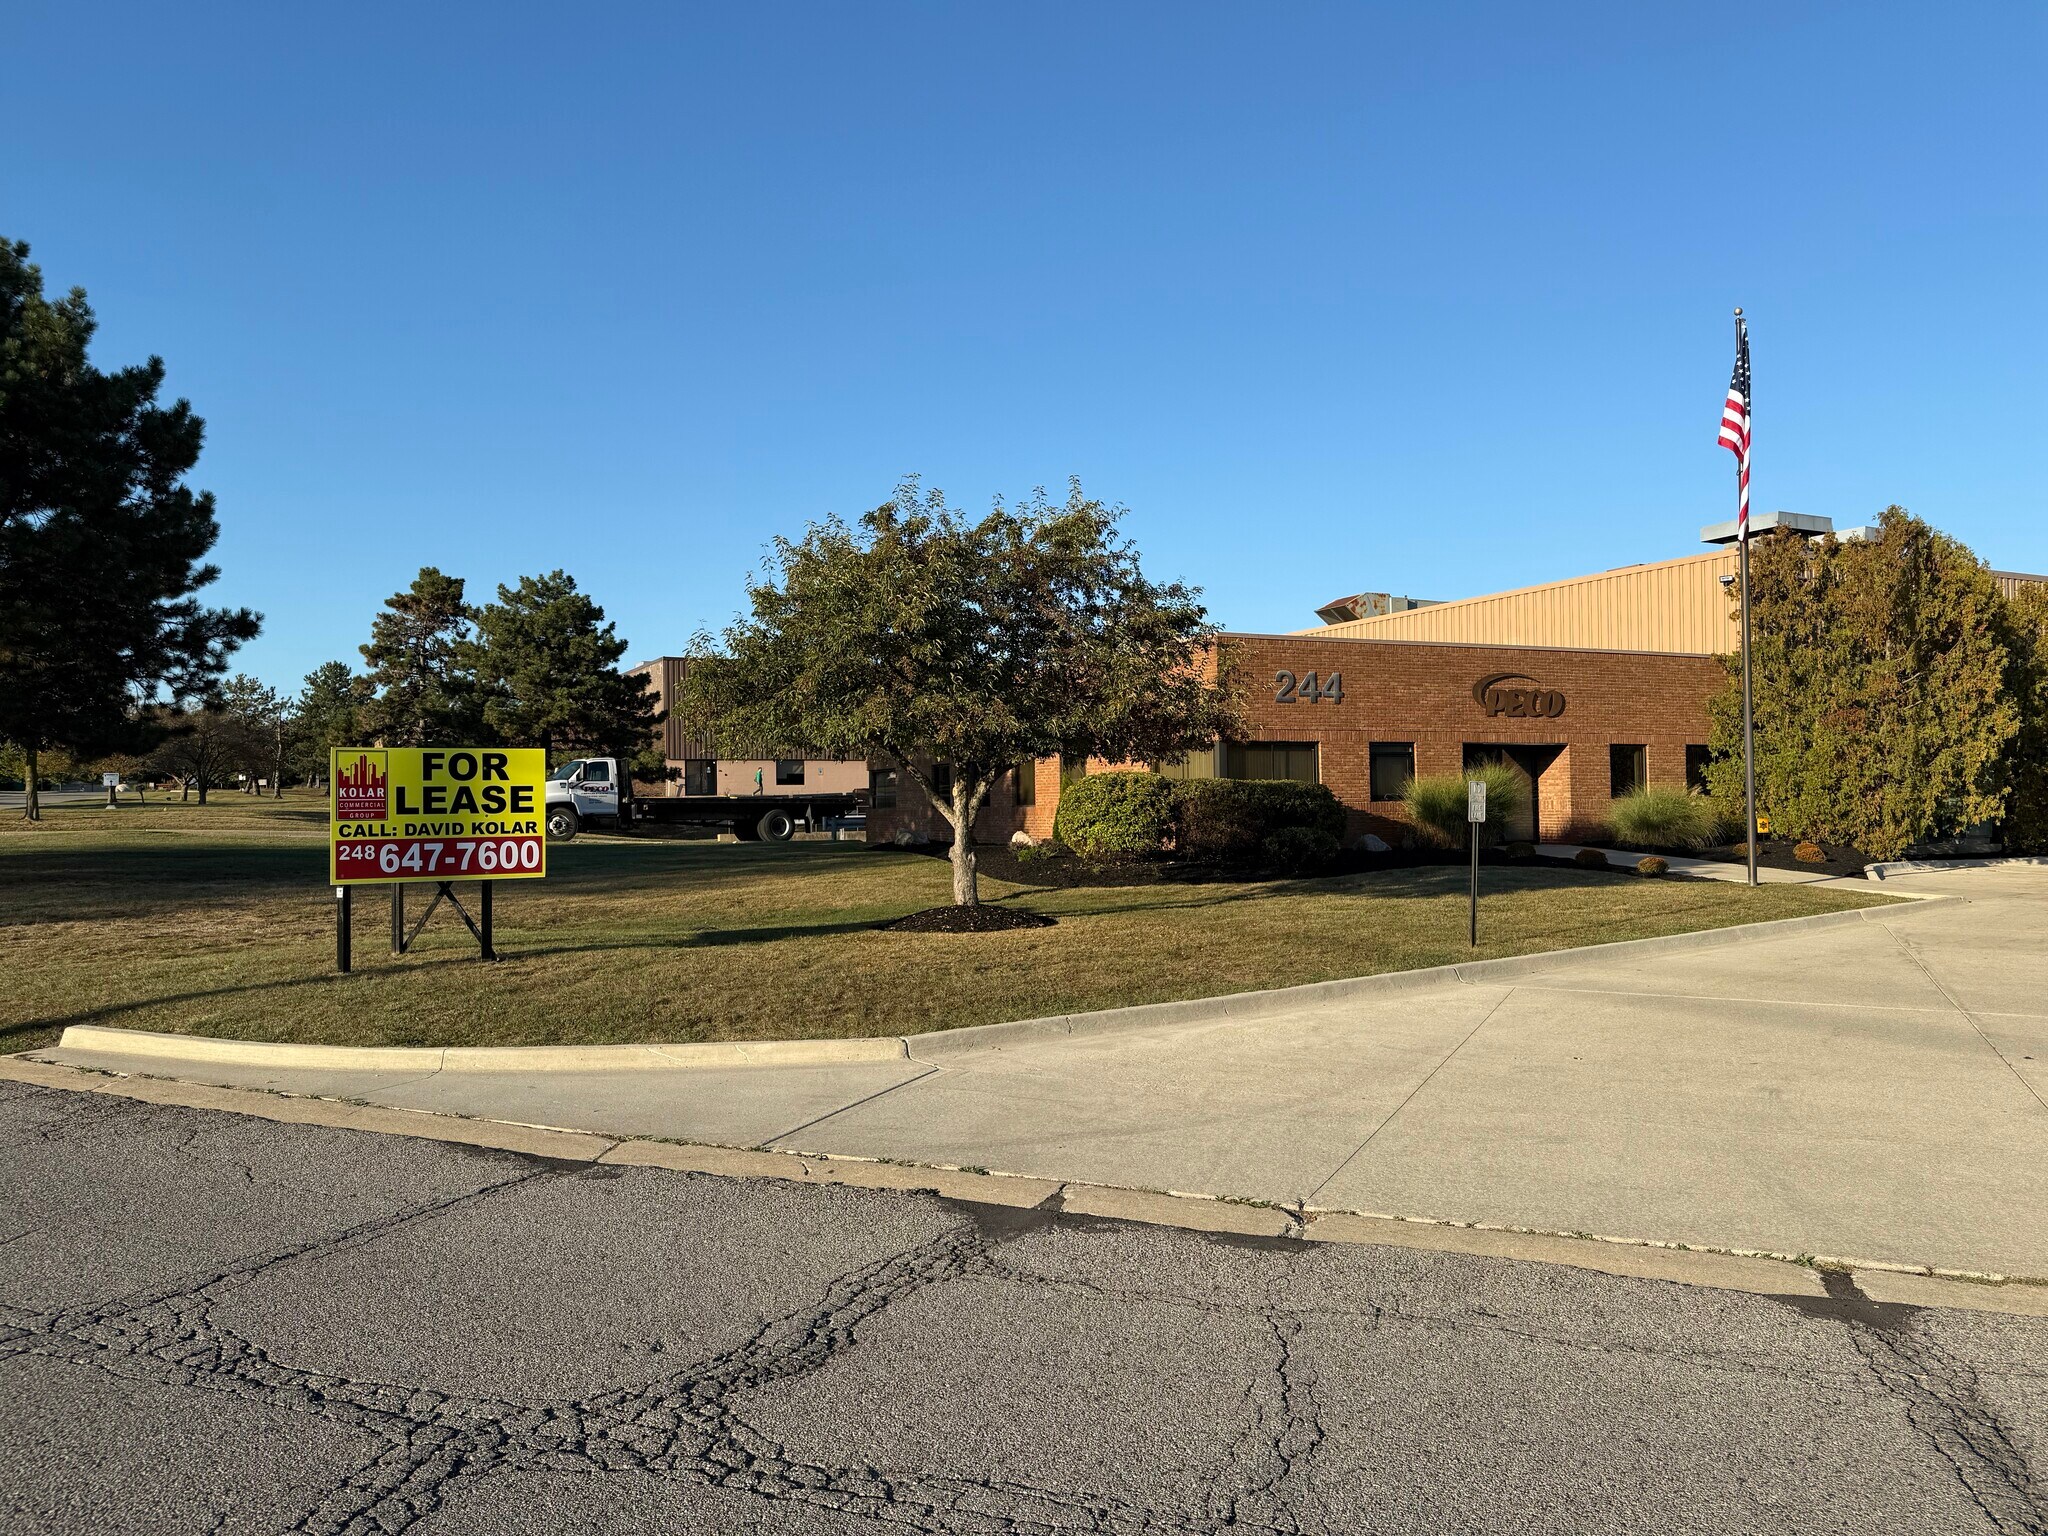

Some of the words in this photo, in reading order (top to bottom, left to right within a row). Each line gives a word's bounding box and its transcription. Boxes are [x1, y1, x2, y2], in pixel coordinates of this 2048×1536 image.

[1275, 669, 1345, 705] 244
[1485, 688, 1567, 718] PECO
[422, 752, 510, 782] FOR
[339, 787, 385, 798] KOLAR
[396, 785, 534, 815] LEASE
[338, 823, 398, 838] CALL:
[404, 821, 465, 837] DAVID
[471, 820, 538, 835] KOLAR
[339, 844, 376, 861] 248
[379, 839, 541, 873] 647-7600
